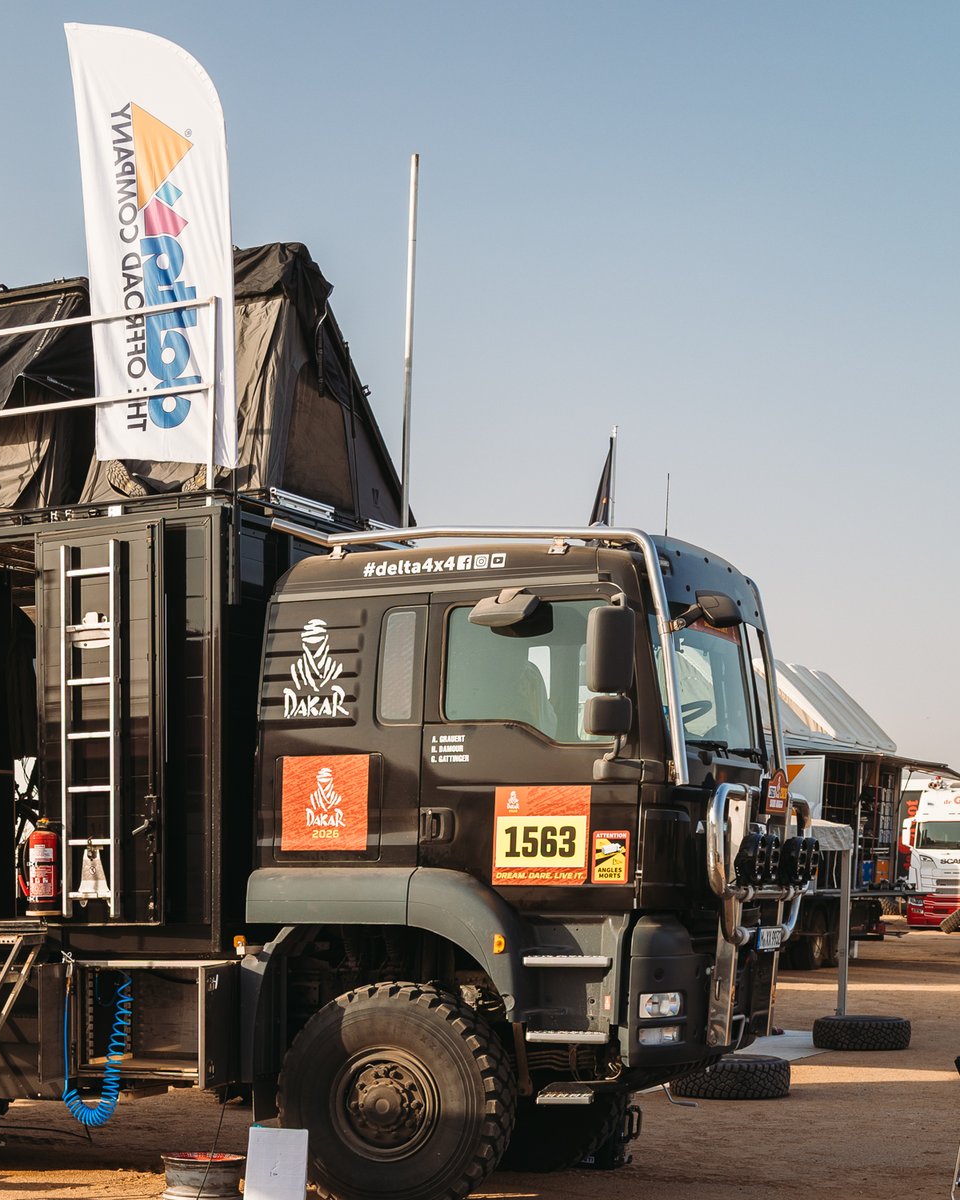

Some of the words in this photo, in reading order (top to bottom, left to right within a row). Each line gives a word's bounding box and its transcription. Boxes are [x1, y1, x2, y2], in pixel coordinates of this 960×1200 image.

[363, 556, 456, 577] #delta4x4
[283, 685, 350, 719] DAKAR
[306, 808, 346, 827] DAKAR
[312, 830, 339, 838] 2026
[505, 826, 576, 858] 1563
